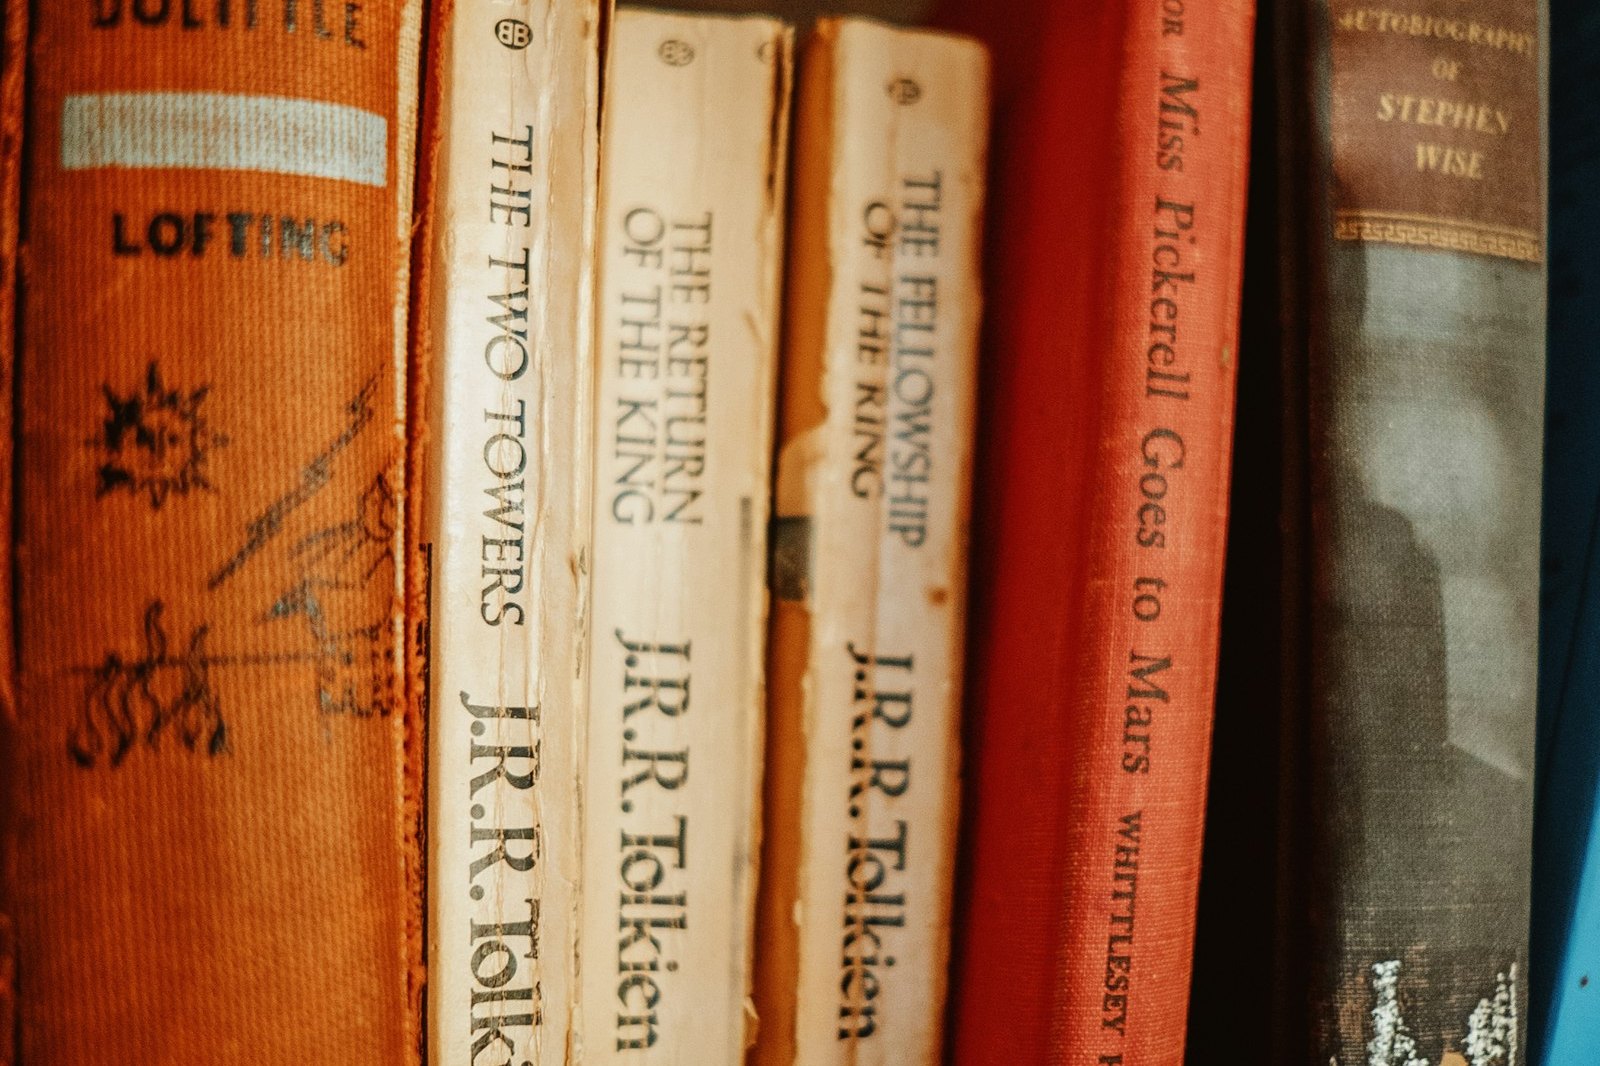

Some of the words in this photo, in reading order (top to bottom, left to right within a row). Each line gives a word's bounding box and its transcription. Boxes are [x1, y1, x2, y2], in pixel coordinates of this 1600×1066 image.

[1156, 70, 1200, 174] Miss
[1376, 92, 1512, 136] STEPHEN
[1415, 142, 1484, 181] WISE
[489, 125, 533, 228] THE
[621, 206, 667, 269] OF
[861, 201, 900, 256] OF
[901, 169, 944, 259] THE
[111, 210, 349, 268] LOFTING
[667, 210, 713, 305] THE
[1145, 194, 1196, 402] Pickerell
[484, 247, 531, 382] TWO
[617, 284, 663, 381] THE
[855, 281, 893, 366] THE
[611, 397, 659, 528] KING
[661, 320, 710, 527] RETURN
[886, 274, 939, 550] FELLOWSHIP
[481, 399, 528, 629] TOWERS
[1136, 428, 1186, 548] Goes
[1131, 575, 1168, 624] to
[615, 627, 692, 814] J.R.R.
[1121, 651, 1173, 775] Mars
[459, 690, 542, 902] J.R.R.
[469, 897, 543, 1066] Tolk
[614, 813, 689, 1053] Tolkien
[837, 818, 908, 1042] Tolkien
[1100, 810, 1143, 1037] WHITTLESEY
